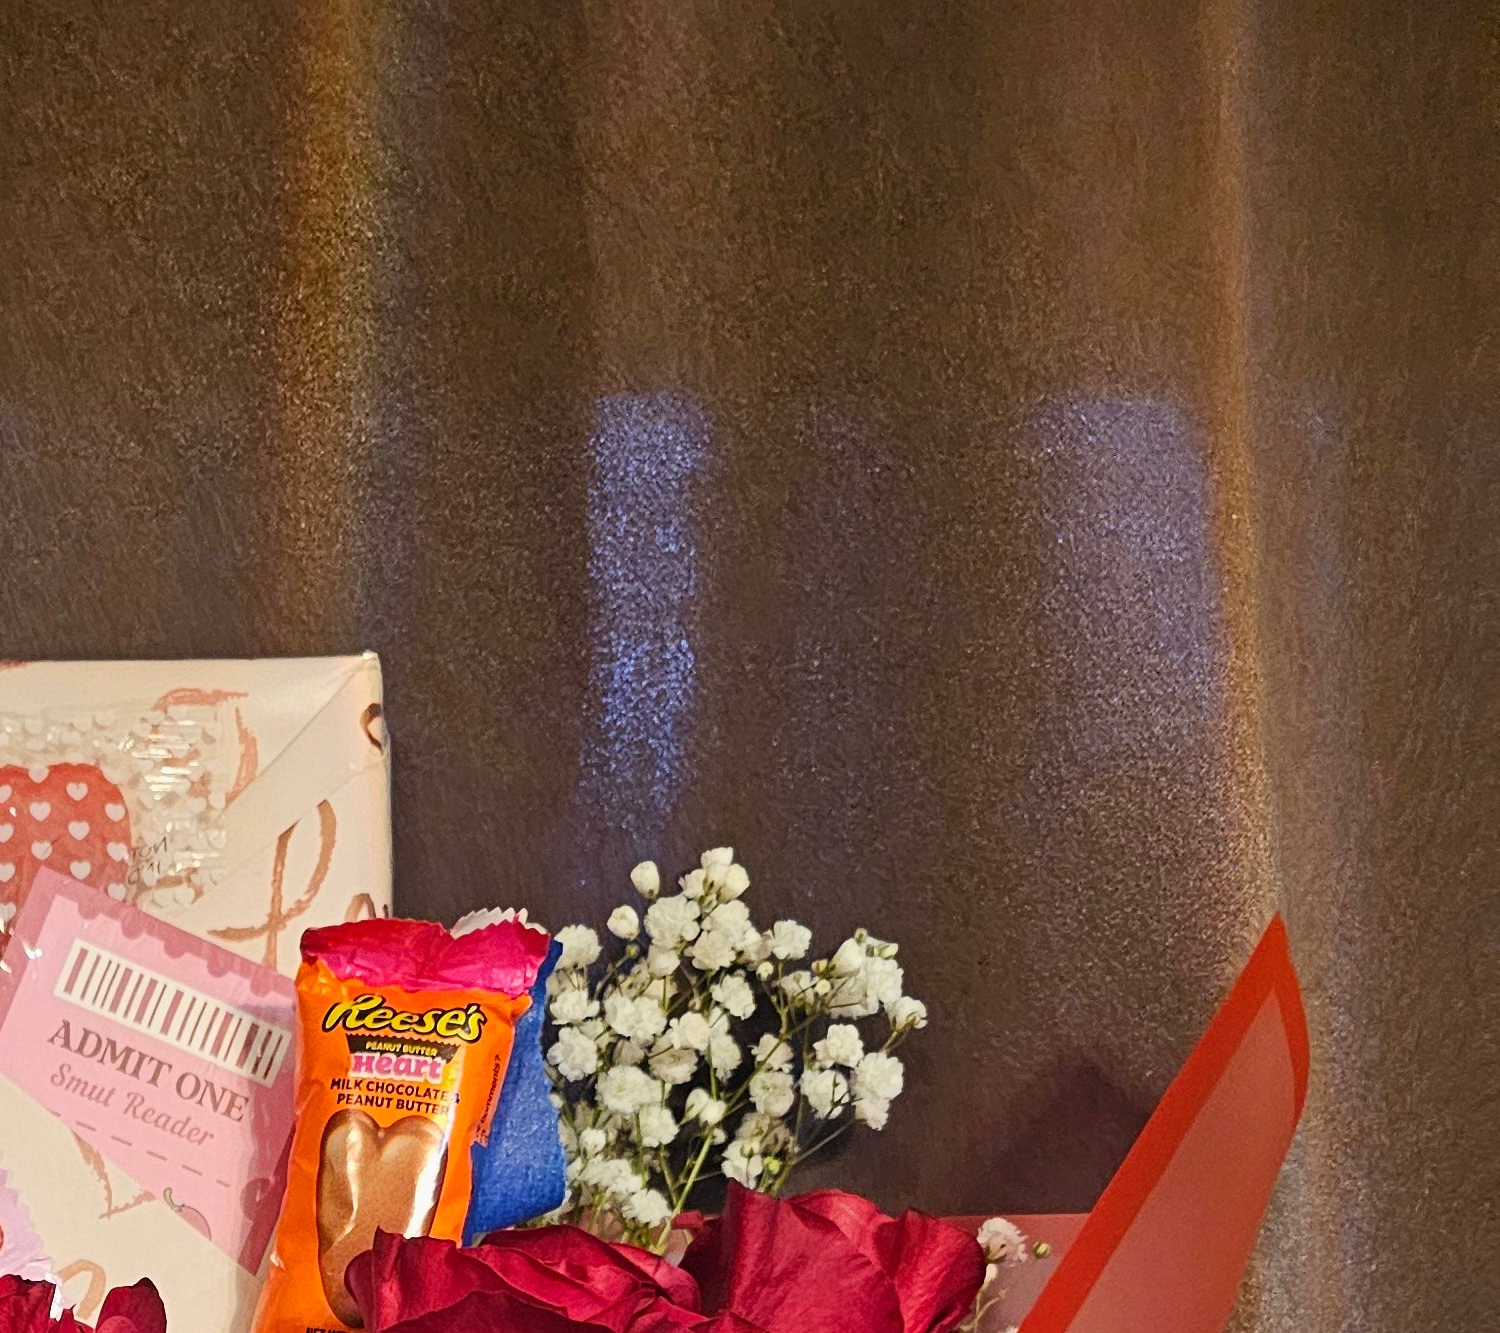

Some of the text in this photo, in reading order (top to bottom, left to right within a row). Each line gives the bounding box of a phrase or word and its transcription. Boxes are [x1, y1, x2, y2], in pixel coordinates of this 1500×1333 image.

[365, 1041, 438, 1057] PEANUT BUTTER
[47, 1019, 250, 1123] ADMIT ONE
[330, 1078, 363, 1091] MILK
[366, 1081, 450, 1101] CHOCOLATE
[49, 1063, 214, 1146] Smut Reader
[337, 1093, 449, 1115] PEANUT BUTTER
